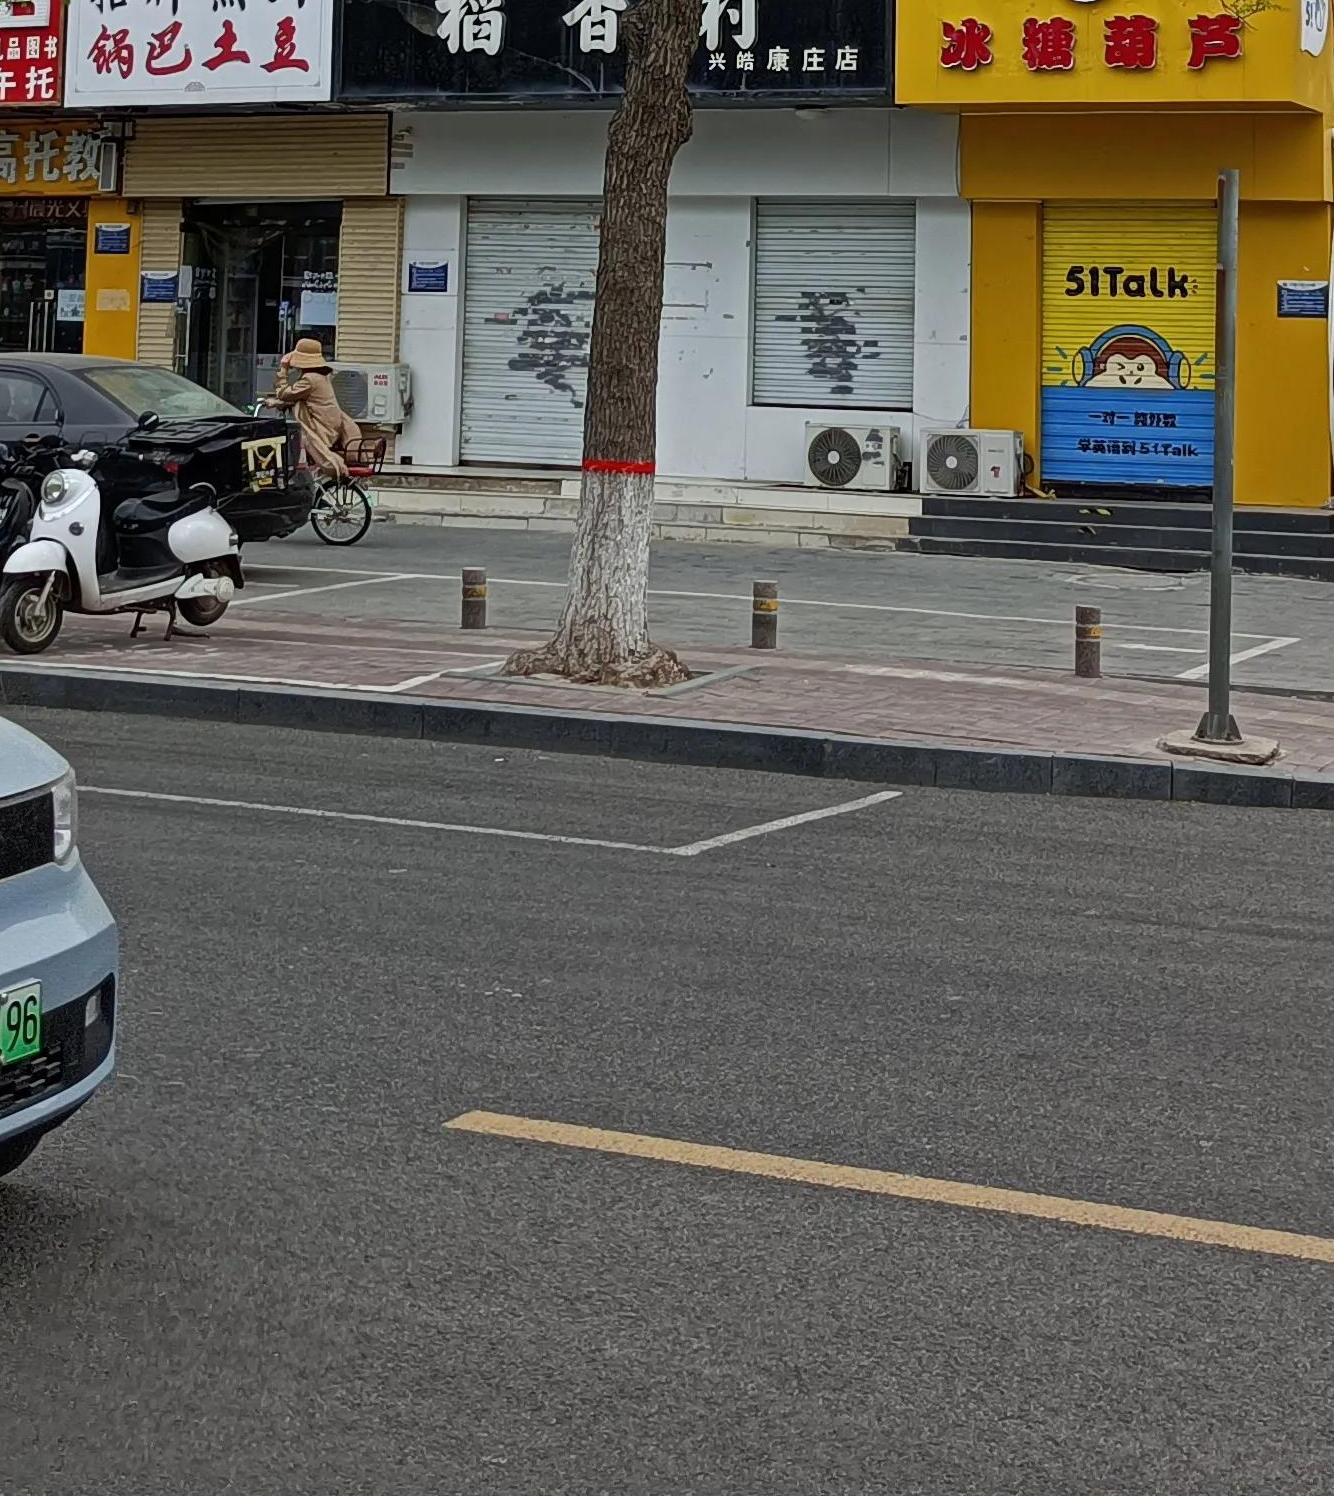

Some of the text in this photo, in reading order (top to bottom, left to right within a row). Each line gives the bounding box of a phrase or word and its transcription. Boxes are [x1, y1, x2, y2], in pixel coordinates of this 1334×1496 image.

[87, 16, 310, 79] 锅巴土豆
[708, 45, 858, 72] 兴皓康庄店
[940, 14, 1242, 71] 冰糖葫芦
[1064, 266, 1188, 298] 51Talk
[1139, 443, 1198, 457] 51Talk
